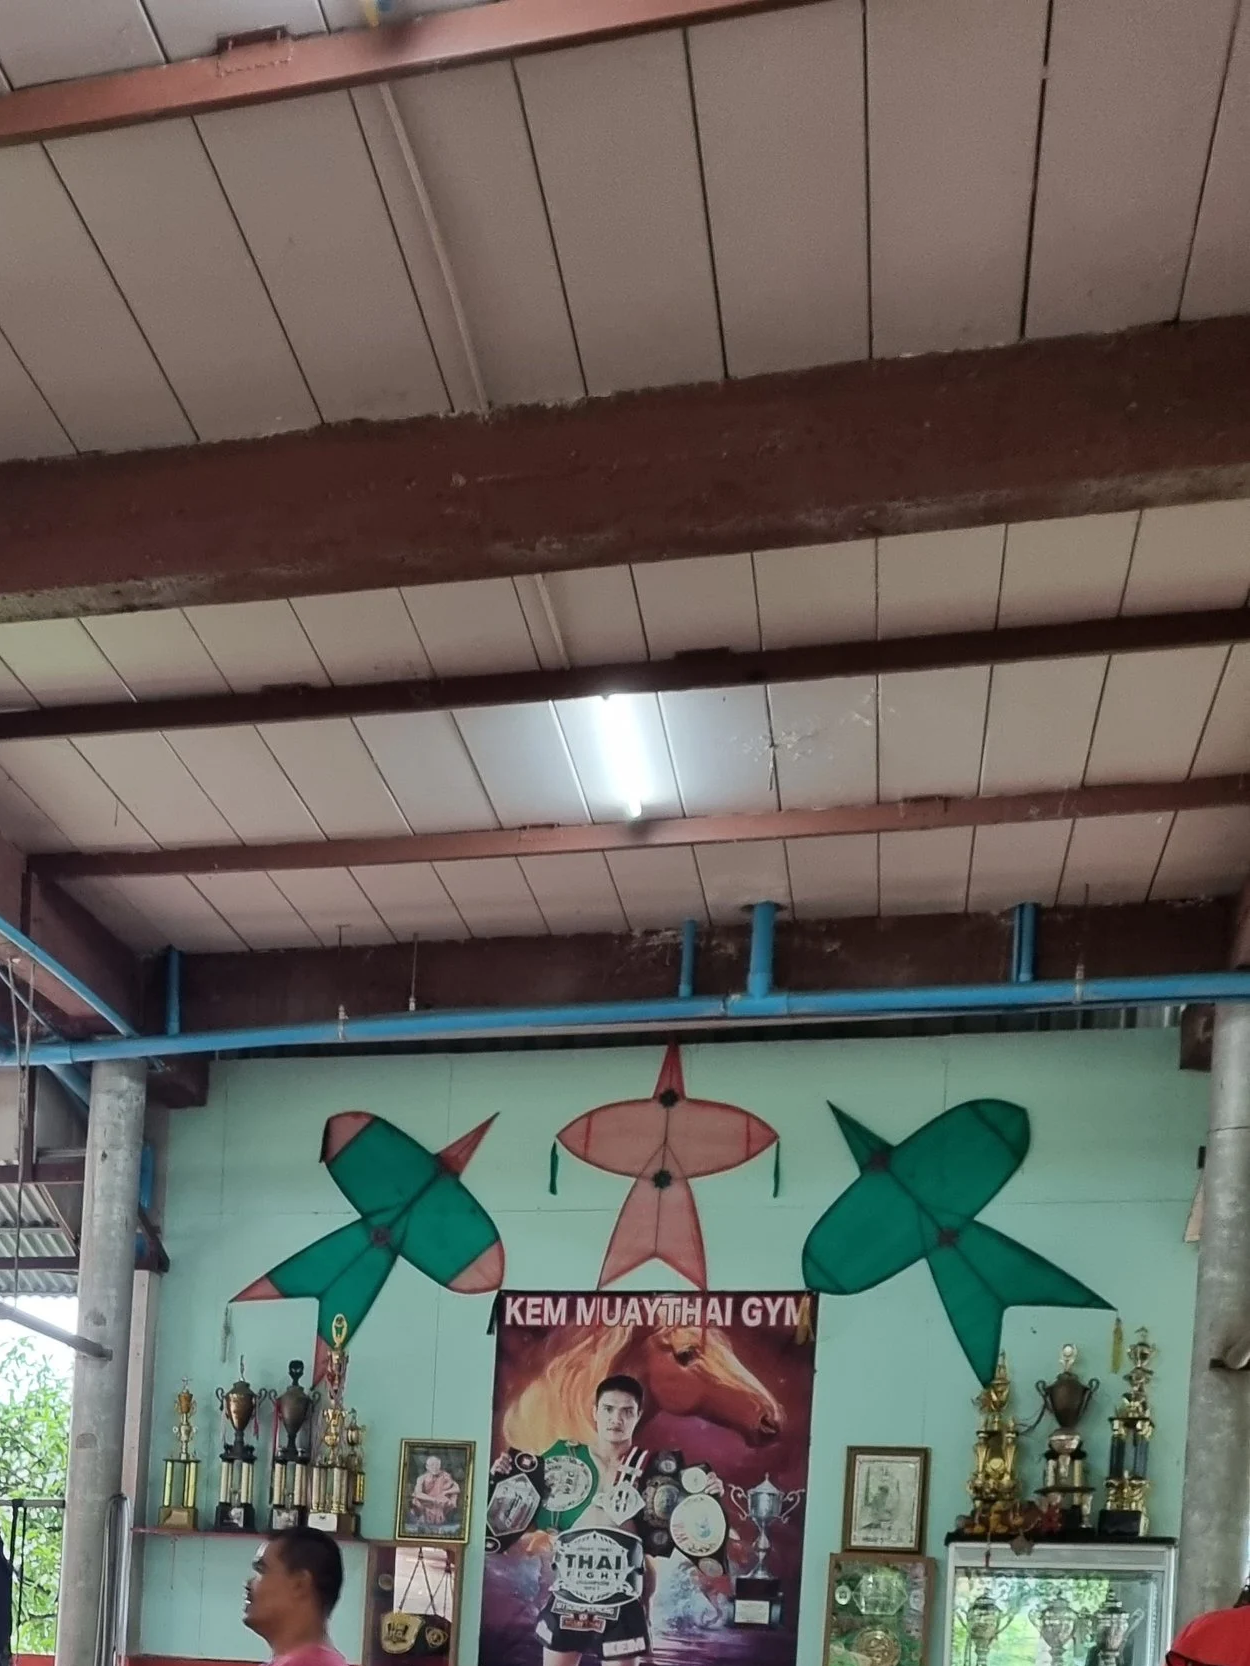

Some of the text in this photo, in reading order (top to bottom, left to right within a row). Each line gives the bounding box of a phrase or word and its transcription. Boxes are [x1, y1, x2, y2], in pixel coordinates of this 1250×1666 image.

[505, 1297, 567, 1326] KEM
[576, 1297, 733, 1327] MUAYTHAI
[565, 1554, 622, 1570] THAI
[567, 1571, 620, 1580] FIGHT
